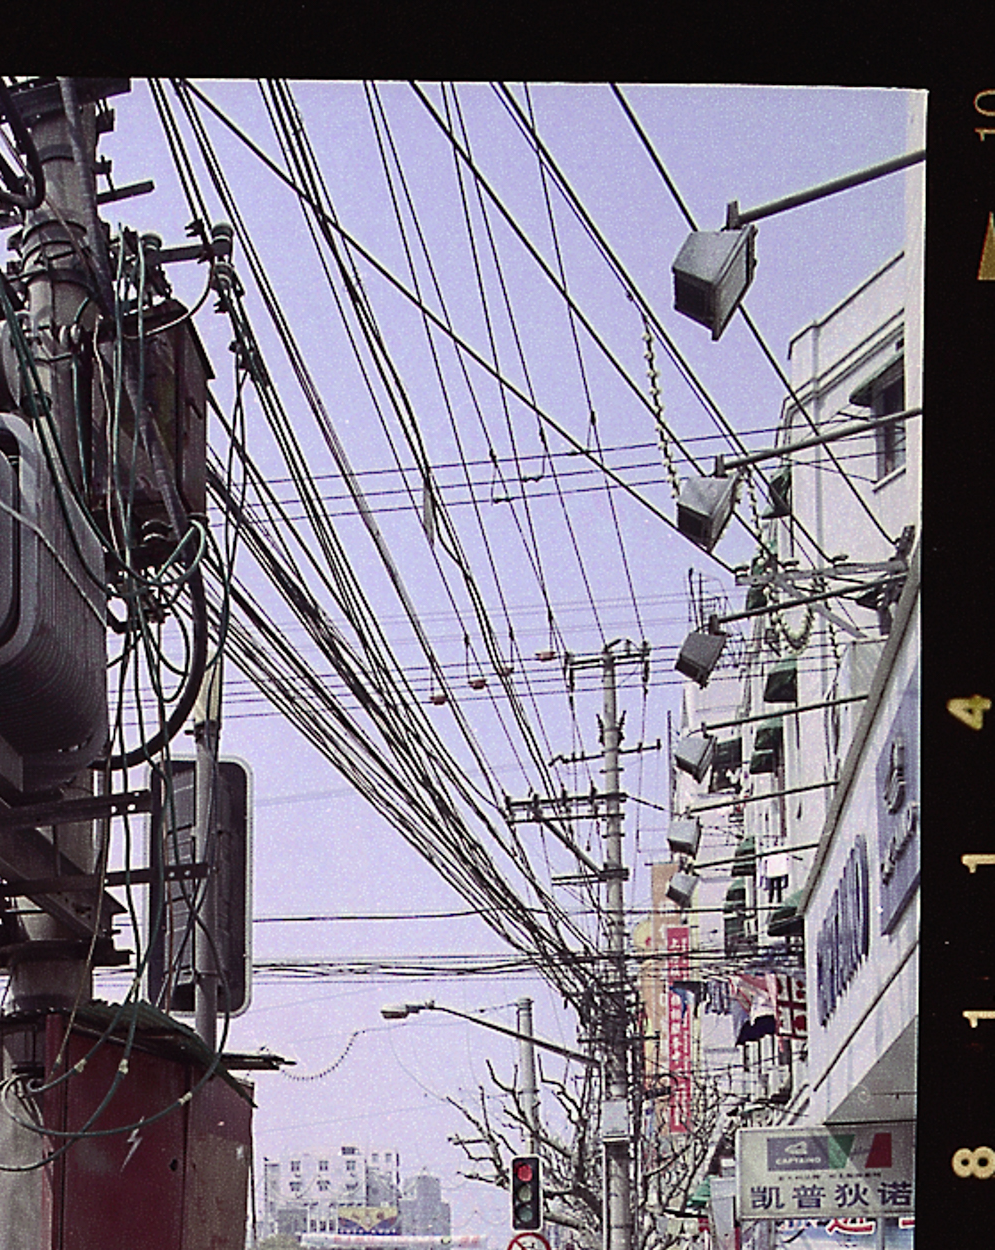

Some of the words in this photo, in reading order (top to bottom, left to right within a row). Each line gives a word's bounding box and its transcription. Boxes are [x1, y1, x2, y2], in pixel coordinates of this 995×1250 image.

[946, 694, 992, 731] 4
[951, 1145, 995, 1180] 8
[750, 1181, 913, 1210] 凯普狄诺
